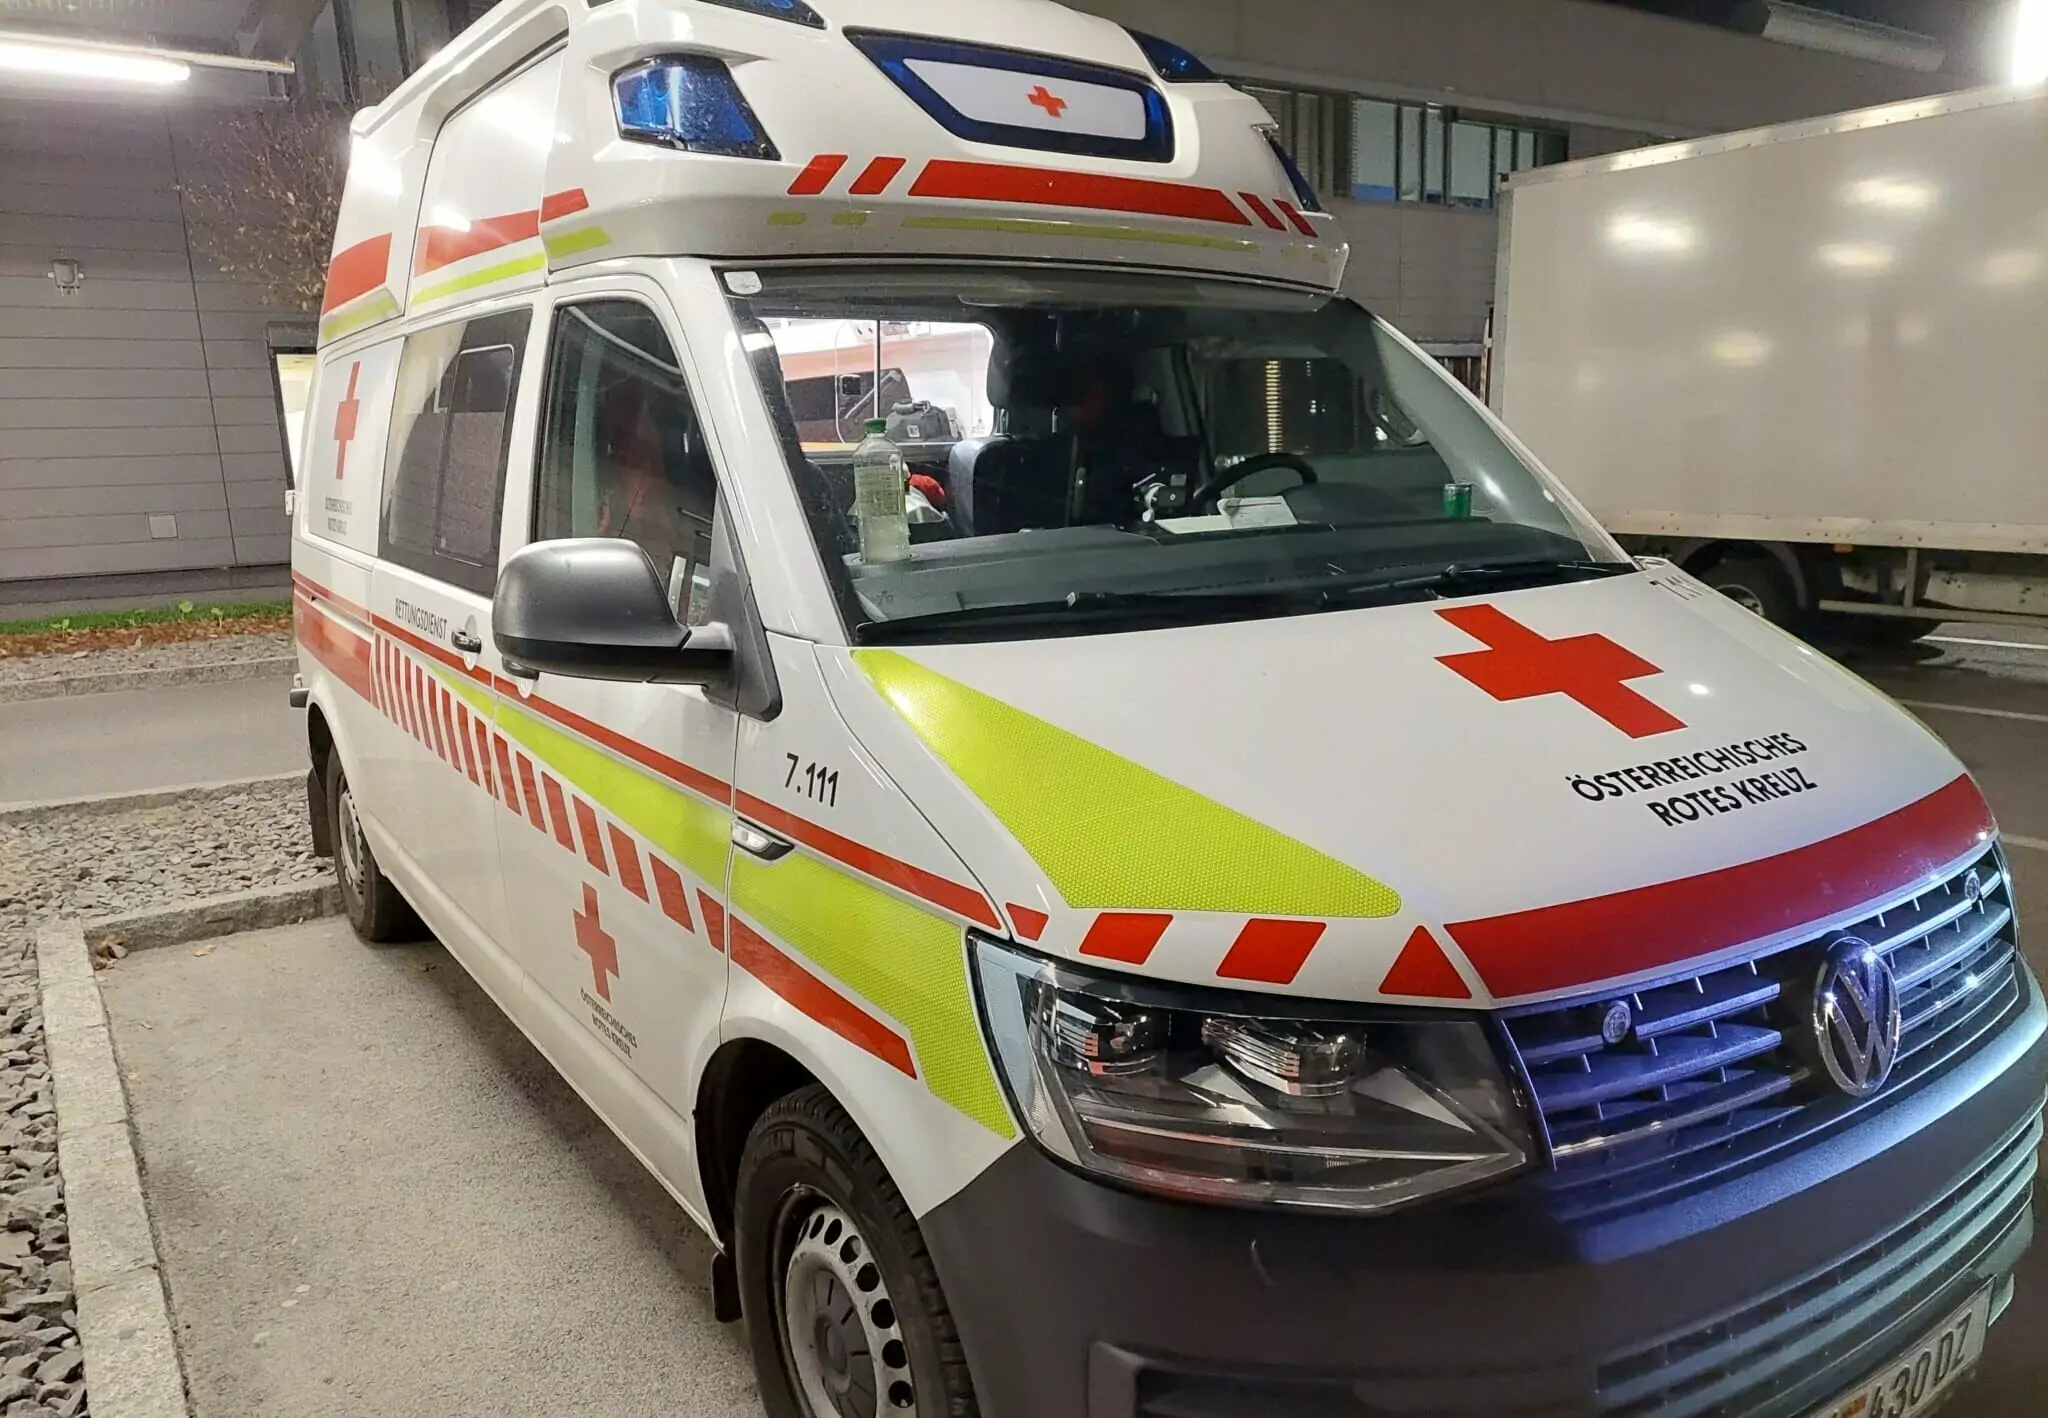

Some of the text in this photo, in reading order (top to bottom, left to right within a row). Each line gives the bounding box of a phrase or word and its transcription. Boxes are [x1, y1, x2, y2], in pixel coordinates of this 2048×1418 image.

[395, 597, 448, 641] RETTUNGSDIENST
[785, 752, 839, 808] 7.111
[1565, 732, 1808, 802] ÖSTERREICHISCHES
[1646, 766, 1819, 827] ROTES KREUZ
